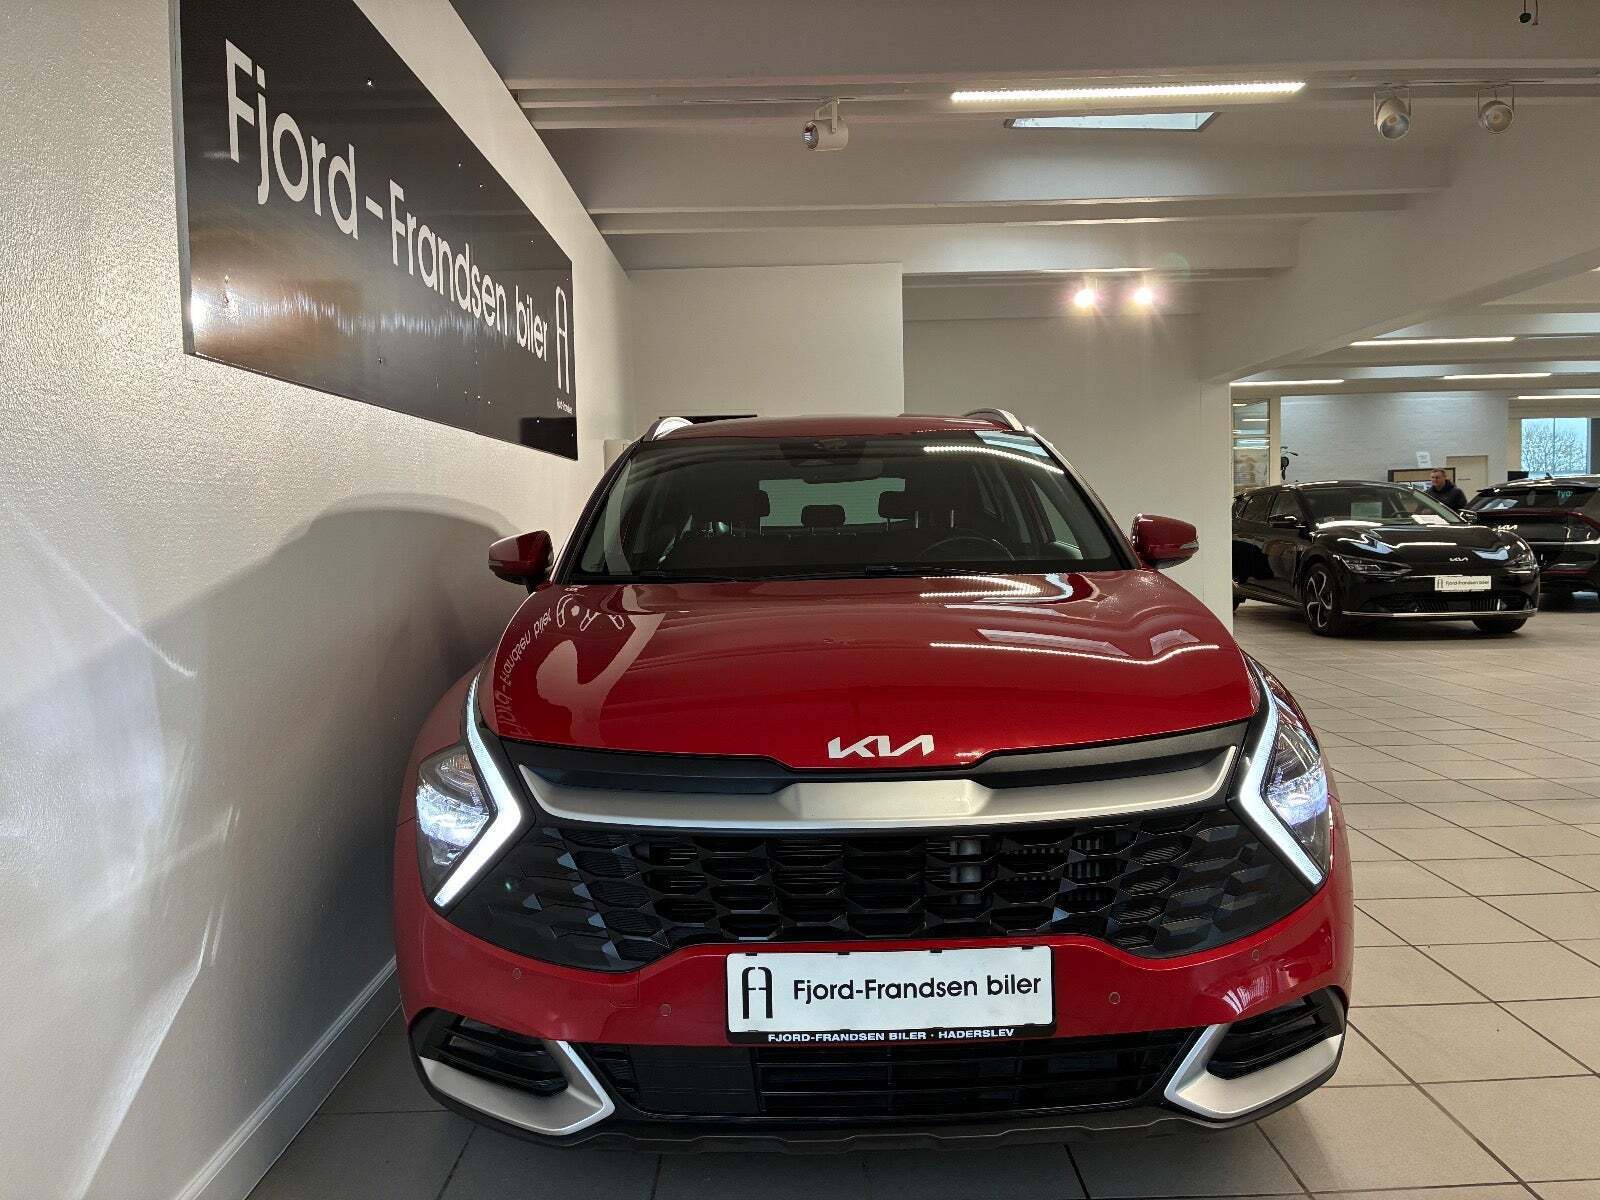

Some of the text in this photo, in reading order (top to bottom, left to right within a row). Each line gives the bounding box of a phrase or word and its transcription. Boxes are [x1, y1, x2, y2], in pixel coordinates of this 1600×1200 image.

[515, 284, 549, 362] biler
[828, 734, 935, 759] KIA
[793, 974, 1042, 1004] Fjord-Frandsen biler
[768, 1028, 1015, 1043] FJORD-FRANDSEN BILER HADERSLEV
